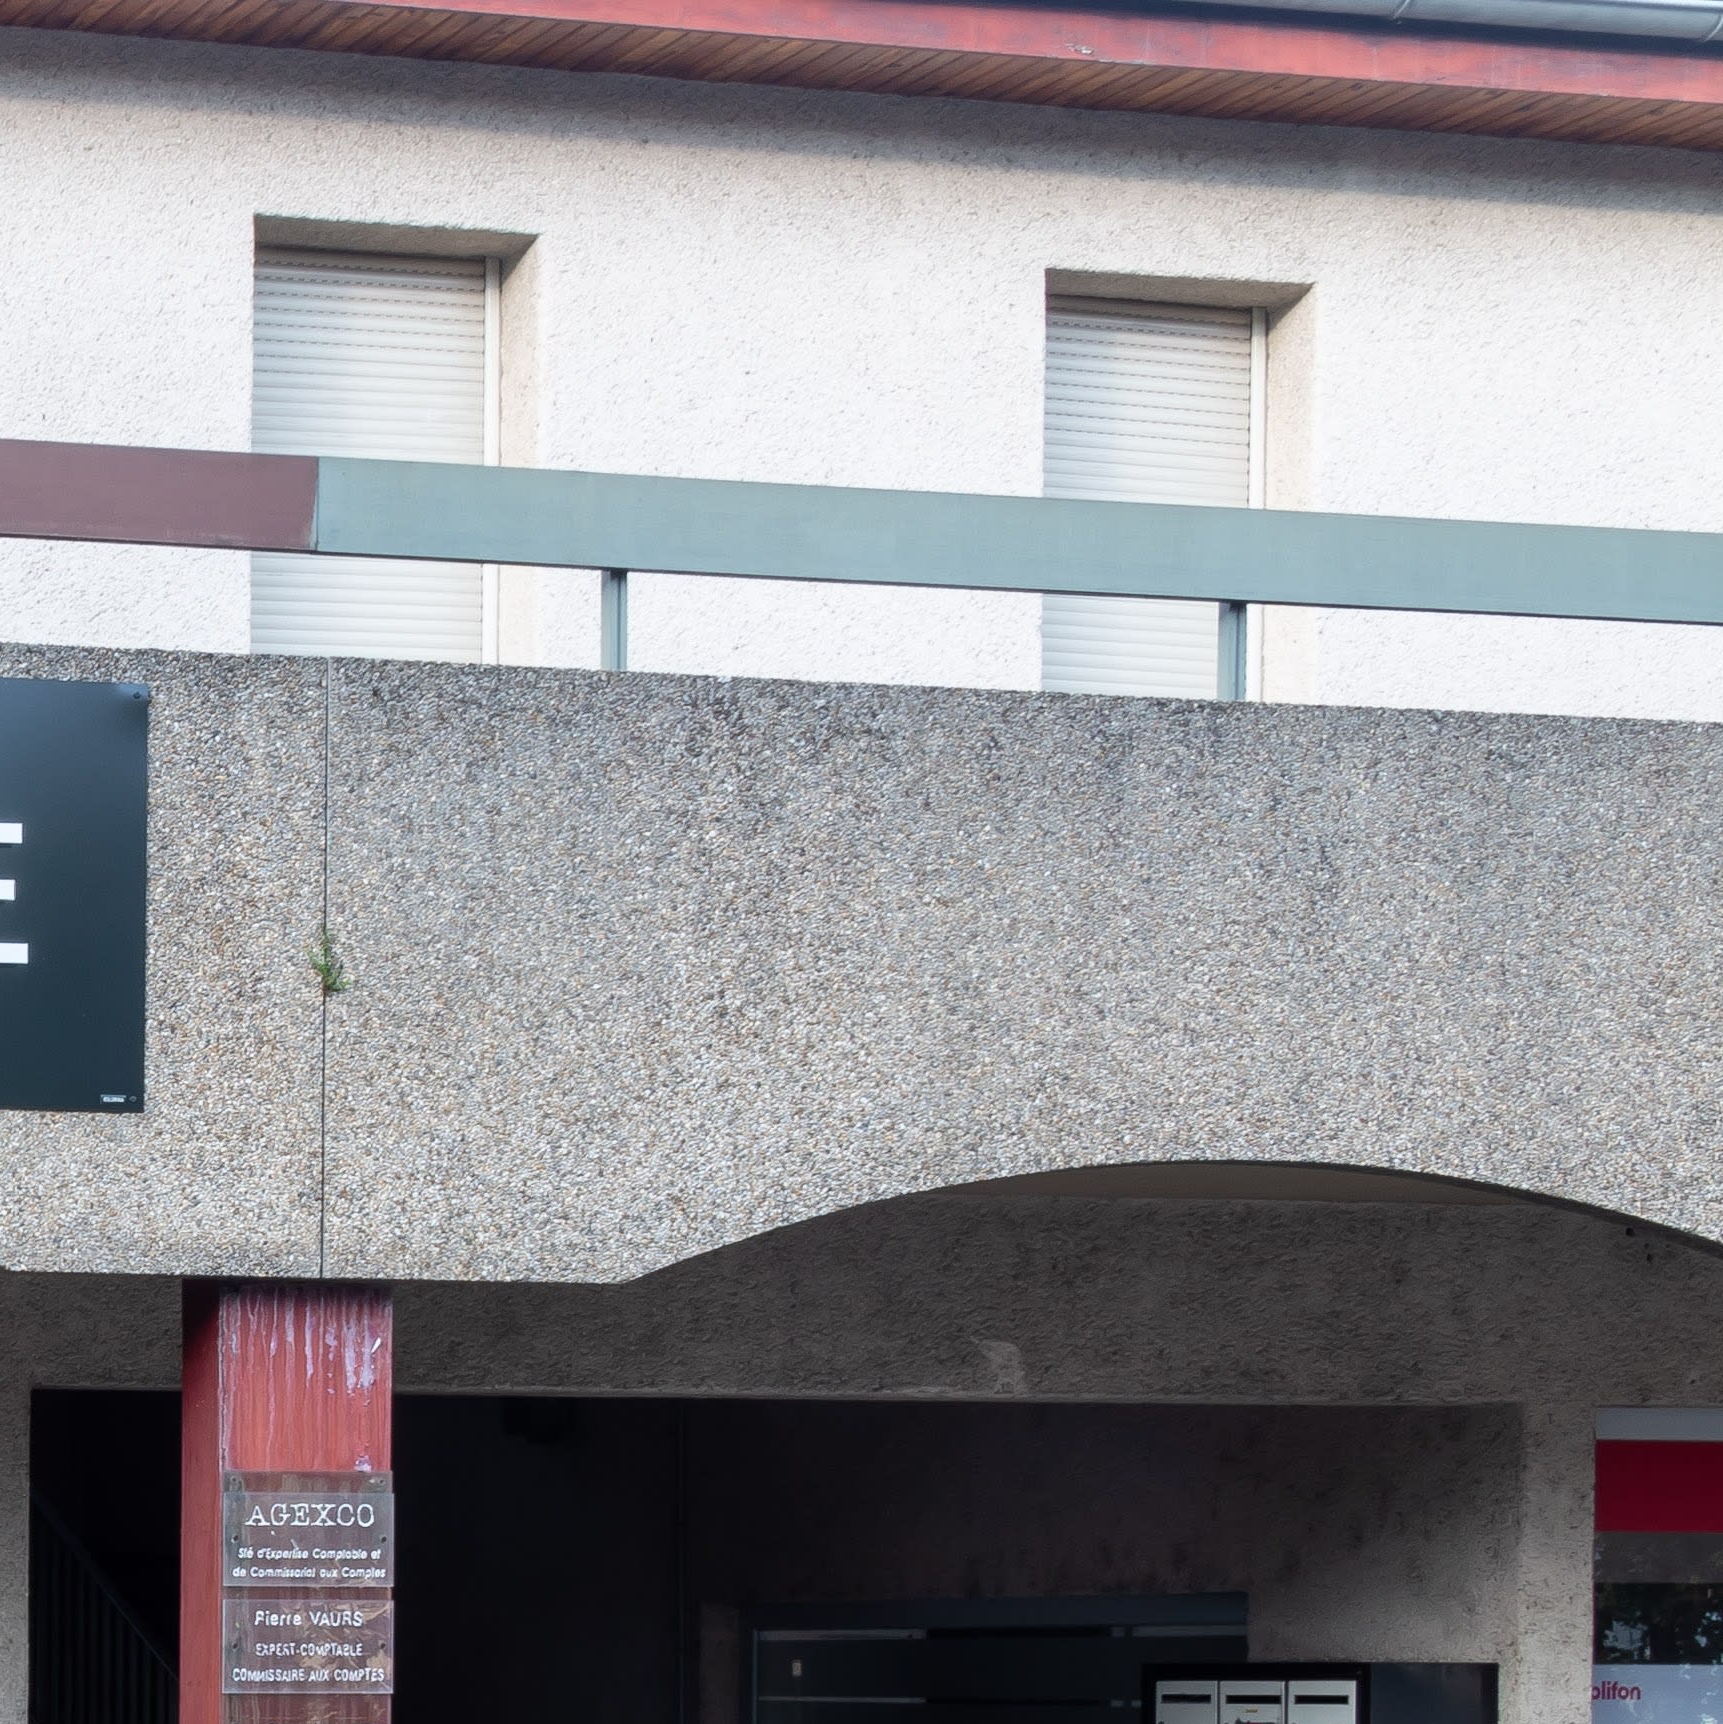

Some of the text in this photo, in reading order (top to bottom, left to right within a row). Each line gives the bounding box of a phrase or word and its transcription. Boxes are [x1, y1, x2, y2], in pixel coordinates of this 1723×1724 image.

[245, 1503, 374, 1527] AGEXCO
[254, 1609, 363, 1627] Pierre VAURS
[255, 1643, 363, 1657] EXPERT-COMPTABLE
[232, 1668, 385, 1681] COMMISSAIRE AUX COMPTES
